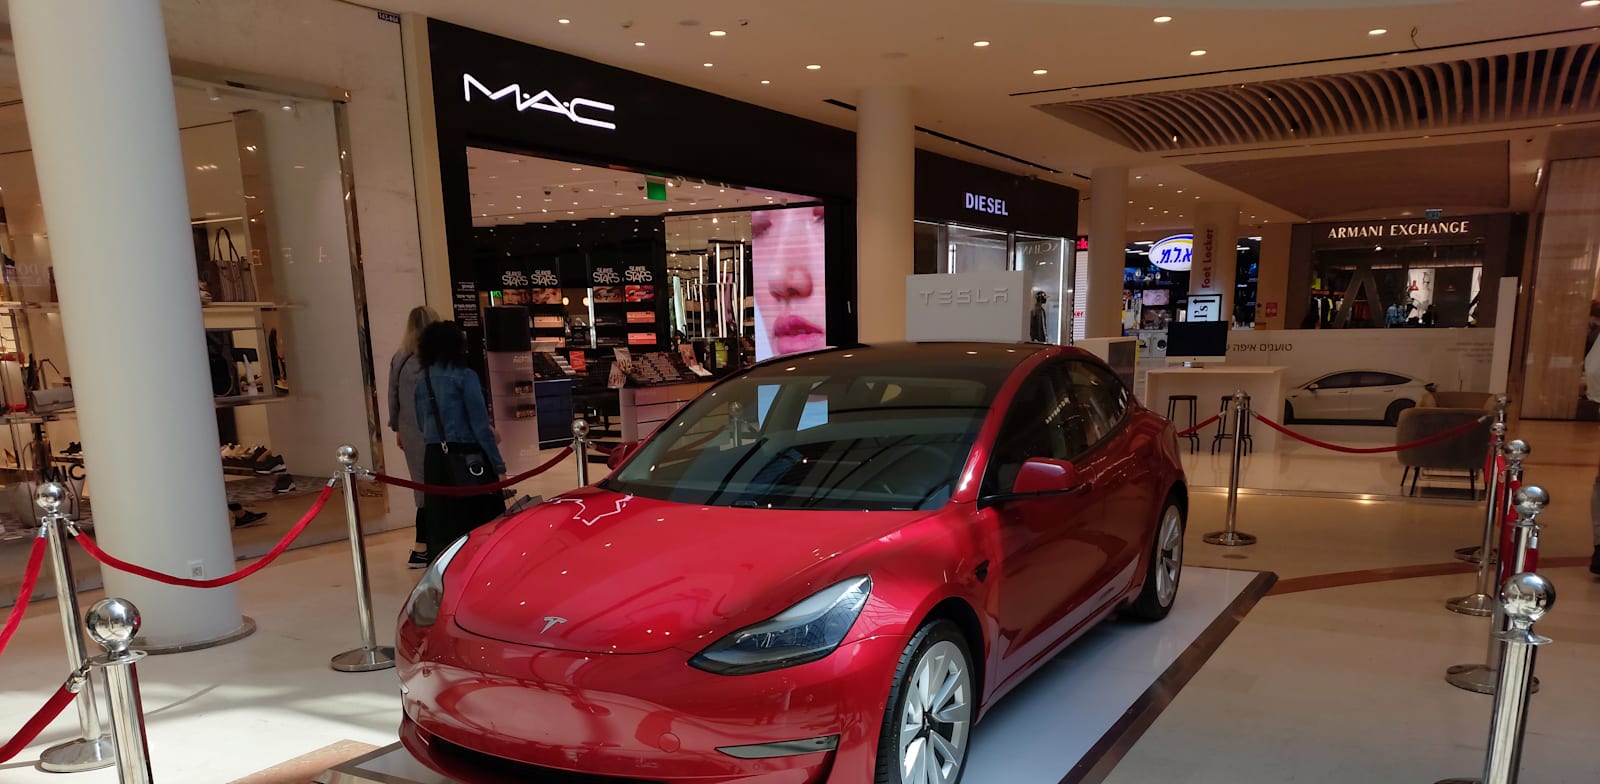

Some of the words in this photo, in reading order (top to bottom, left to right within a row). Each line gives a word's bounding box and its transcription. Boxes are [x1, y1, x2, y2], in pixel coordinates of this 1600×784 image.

[965, 192, 1009, 216] DIESEL
[1328, 225, 1383, 239] ARMANI
[1390, 221, 1470, 236] EXCHANGE
[502, 275, 529, 287] STARS
[531, 274, 559, 286] STARS
[593, 272, 620, 284] STARS
[625, 270, 653, 283] STARS
[919, 287, 1009, 306] TESLA
[1232, 343, 1257, 352] איפה
